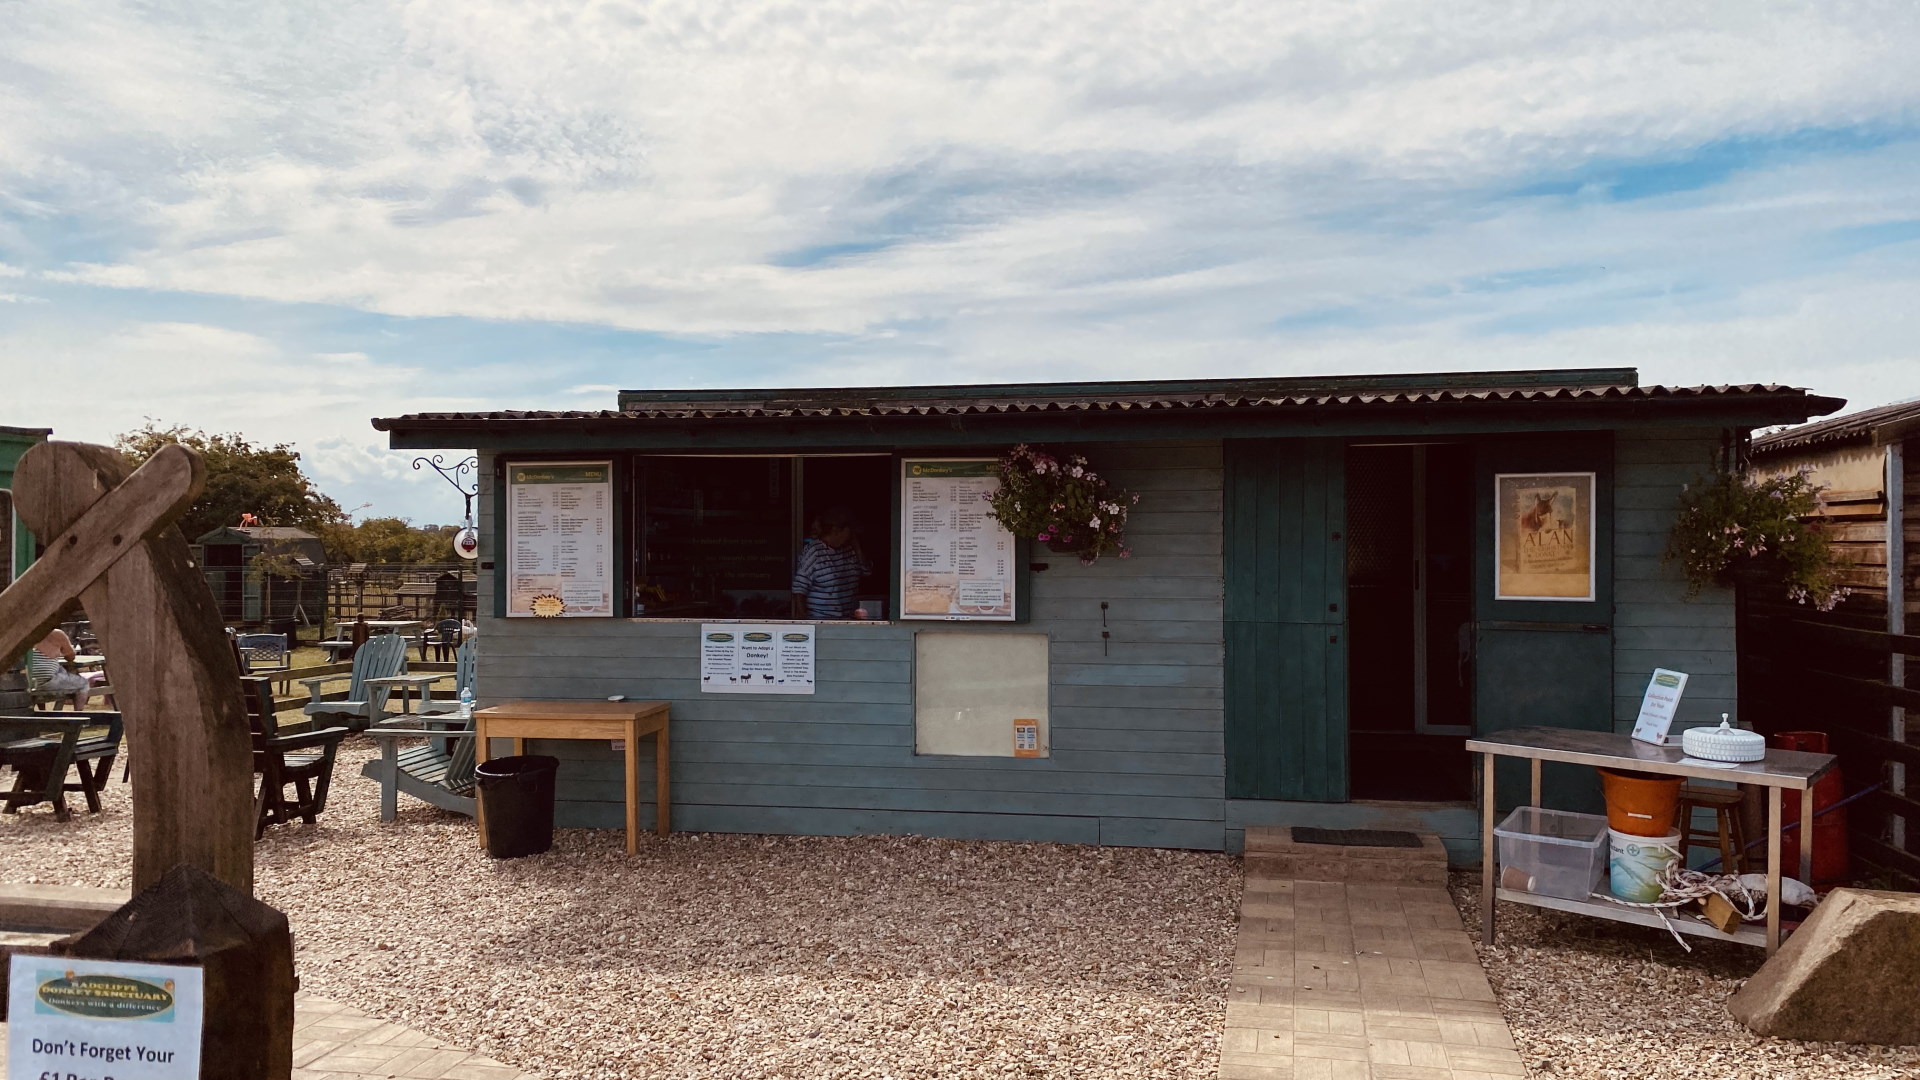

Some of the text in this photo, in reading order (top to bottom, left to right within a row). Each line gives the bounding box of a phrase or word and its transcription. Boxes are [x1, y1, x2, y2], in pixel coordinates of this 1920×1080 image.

[1524, 529, 1574, 547] ALAN
[41, 986, 168, 1001] DONKEY SANCTUARY
[71, 981, 139, 992] RADCLIFFE
[48, 998, 85, 1007] Donkeys
[87, 1000, 107, 1008] with
[116, 1002, 162, 1011] difference
[80, 1041, 132, 1063] Forget
[136, 1046, 175, 1064] Your
